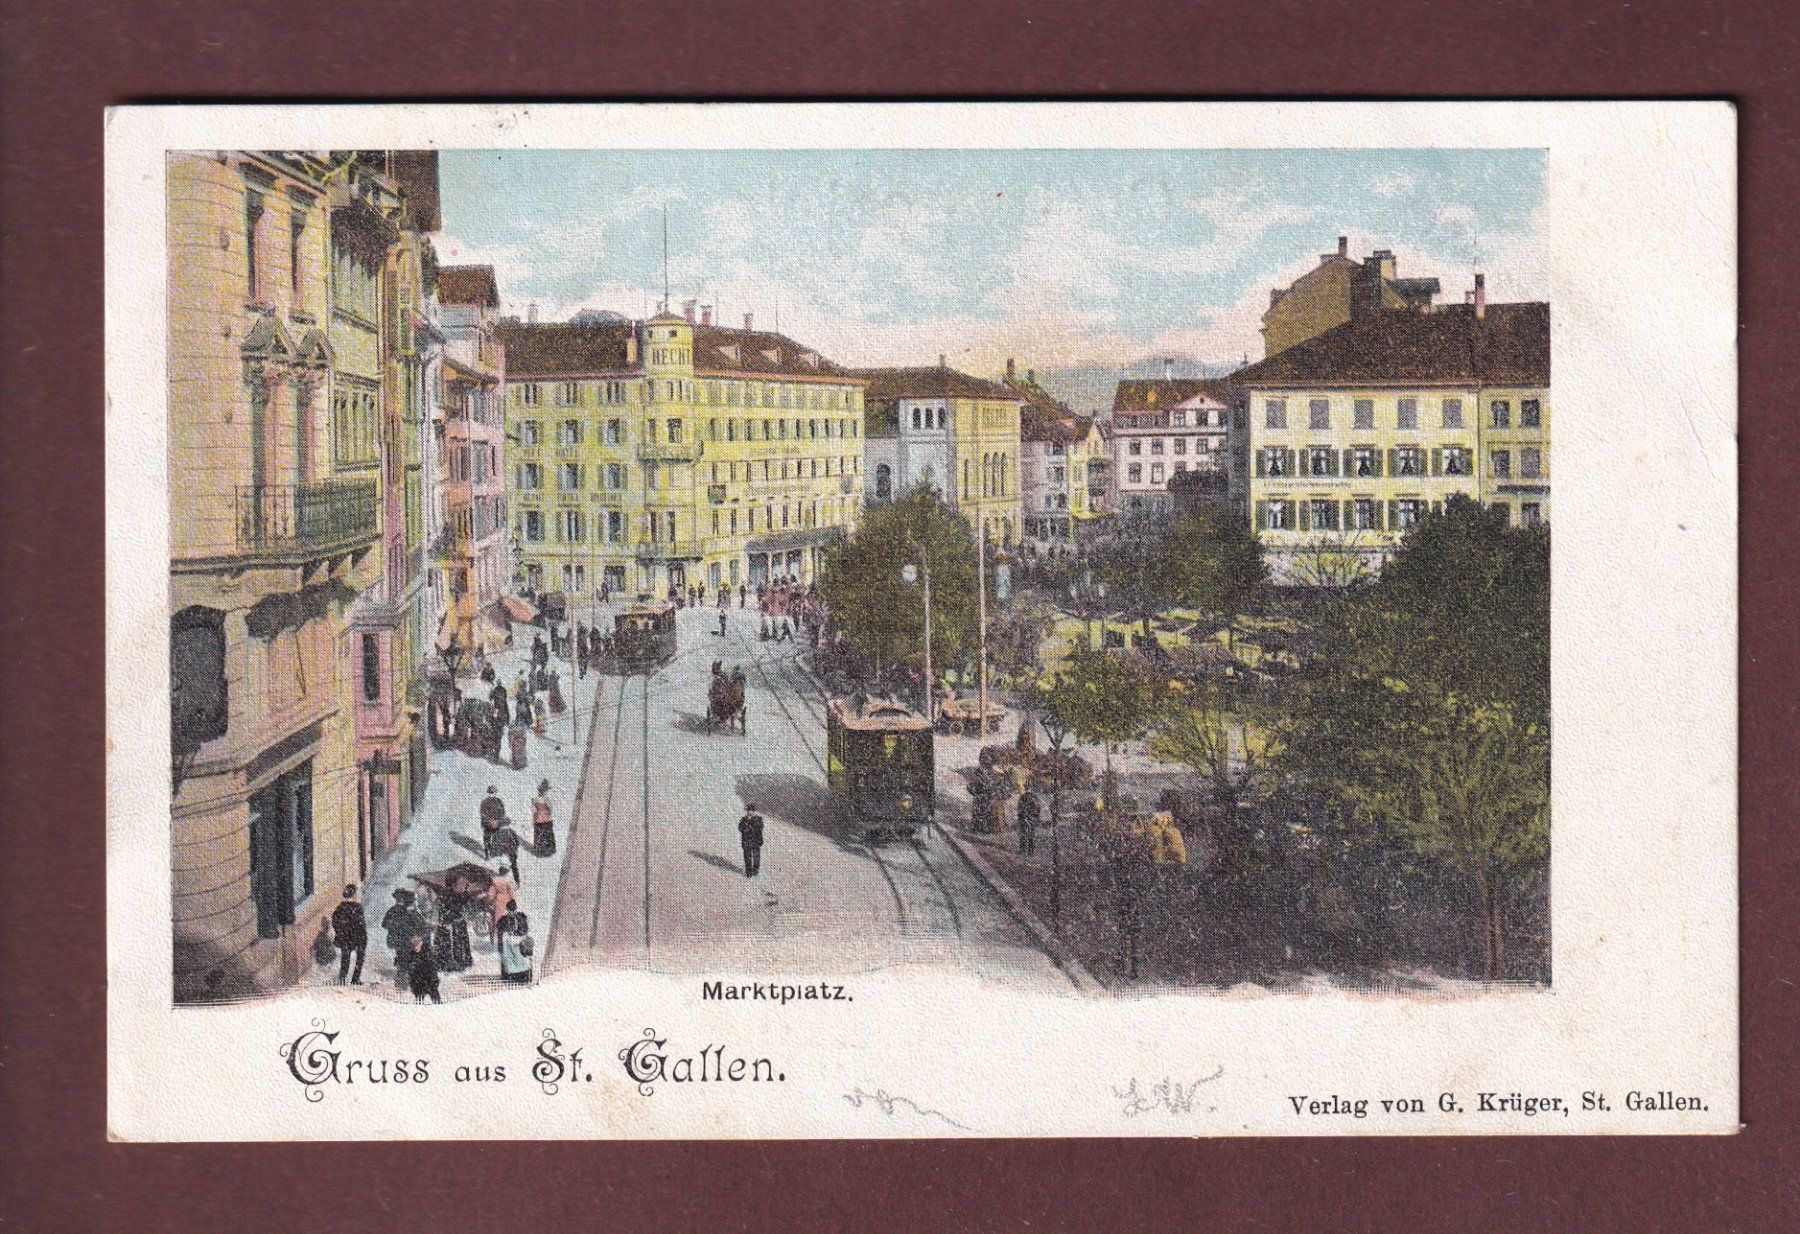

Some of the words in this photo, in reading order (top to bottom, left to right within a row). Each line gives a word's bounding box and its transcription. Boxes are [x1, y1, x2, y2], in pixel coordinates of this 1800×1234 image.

[703, 981, 853, 1006] Marktplatz.
[280, 1021, 430, 1102] Gruss
[453, 1065, 506, 1083] aus
[531, 1027, 593, 1095] St.
[617, 1027, 786, 1096] Gallen.
[1288, 1094, 1368, 1118] Verlag
[1380, 1098, 1425, 1114] von
[1438, 1093, 1464, 1114] G.
[1477, 1093, 1569, 1118] Krüger,
[1582, 1091, 1611, 1112] St.
[1625, 1091, 1709, 1112] Gallen.
